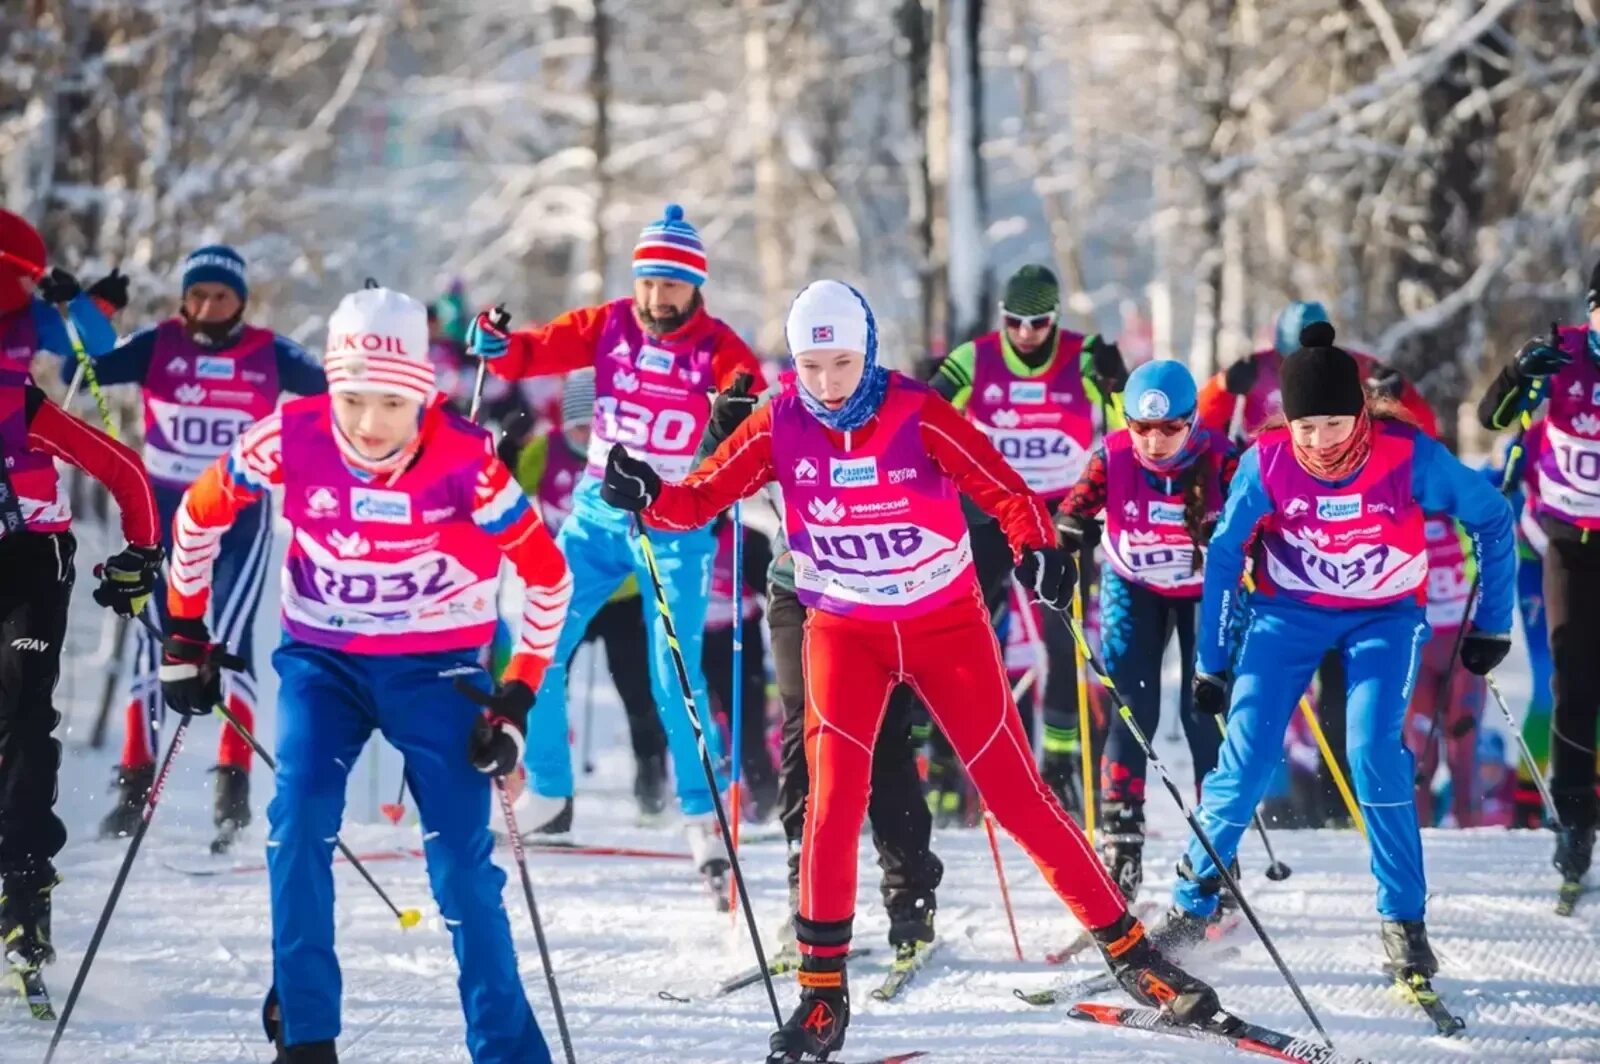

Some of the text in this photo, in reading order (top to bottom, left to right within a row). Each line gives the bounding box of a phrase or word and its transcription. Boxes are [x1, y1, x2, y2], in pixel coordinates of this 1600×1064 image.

[594, 397, 696, 451] 130
[991, 437, 1071, 459] 084
[813, 526, 923, 560] 1018
[1129, 549, 1193, 566] 103
[320, 557, 454, 604] 1032
[1299, 543, 1389, 590] 1037
